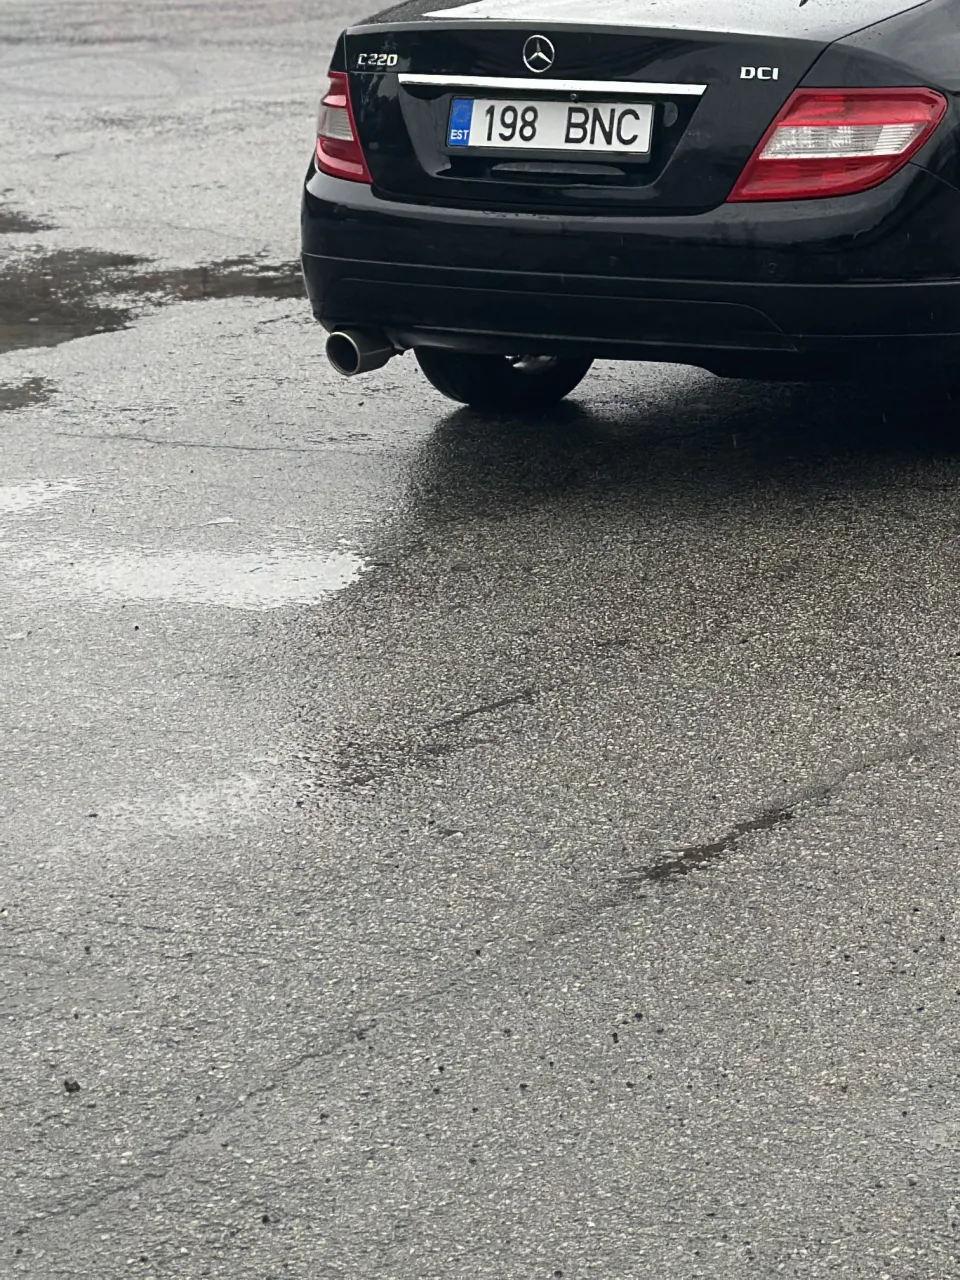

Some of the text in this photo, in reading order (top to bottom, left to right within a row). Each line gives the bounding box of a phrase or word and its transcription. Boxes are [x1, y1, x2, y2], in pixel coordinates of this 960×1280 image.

[740, 66, 779, 80] DCI
[485, 105, 641, 146] 198 BNC
[451, 129, 470, 140] EST
